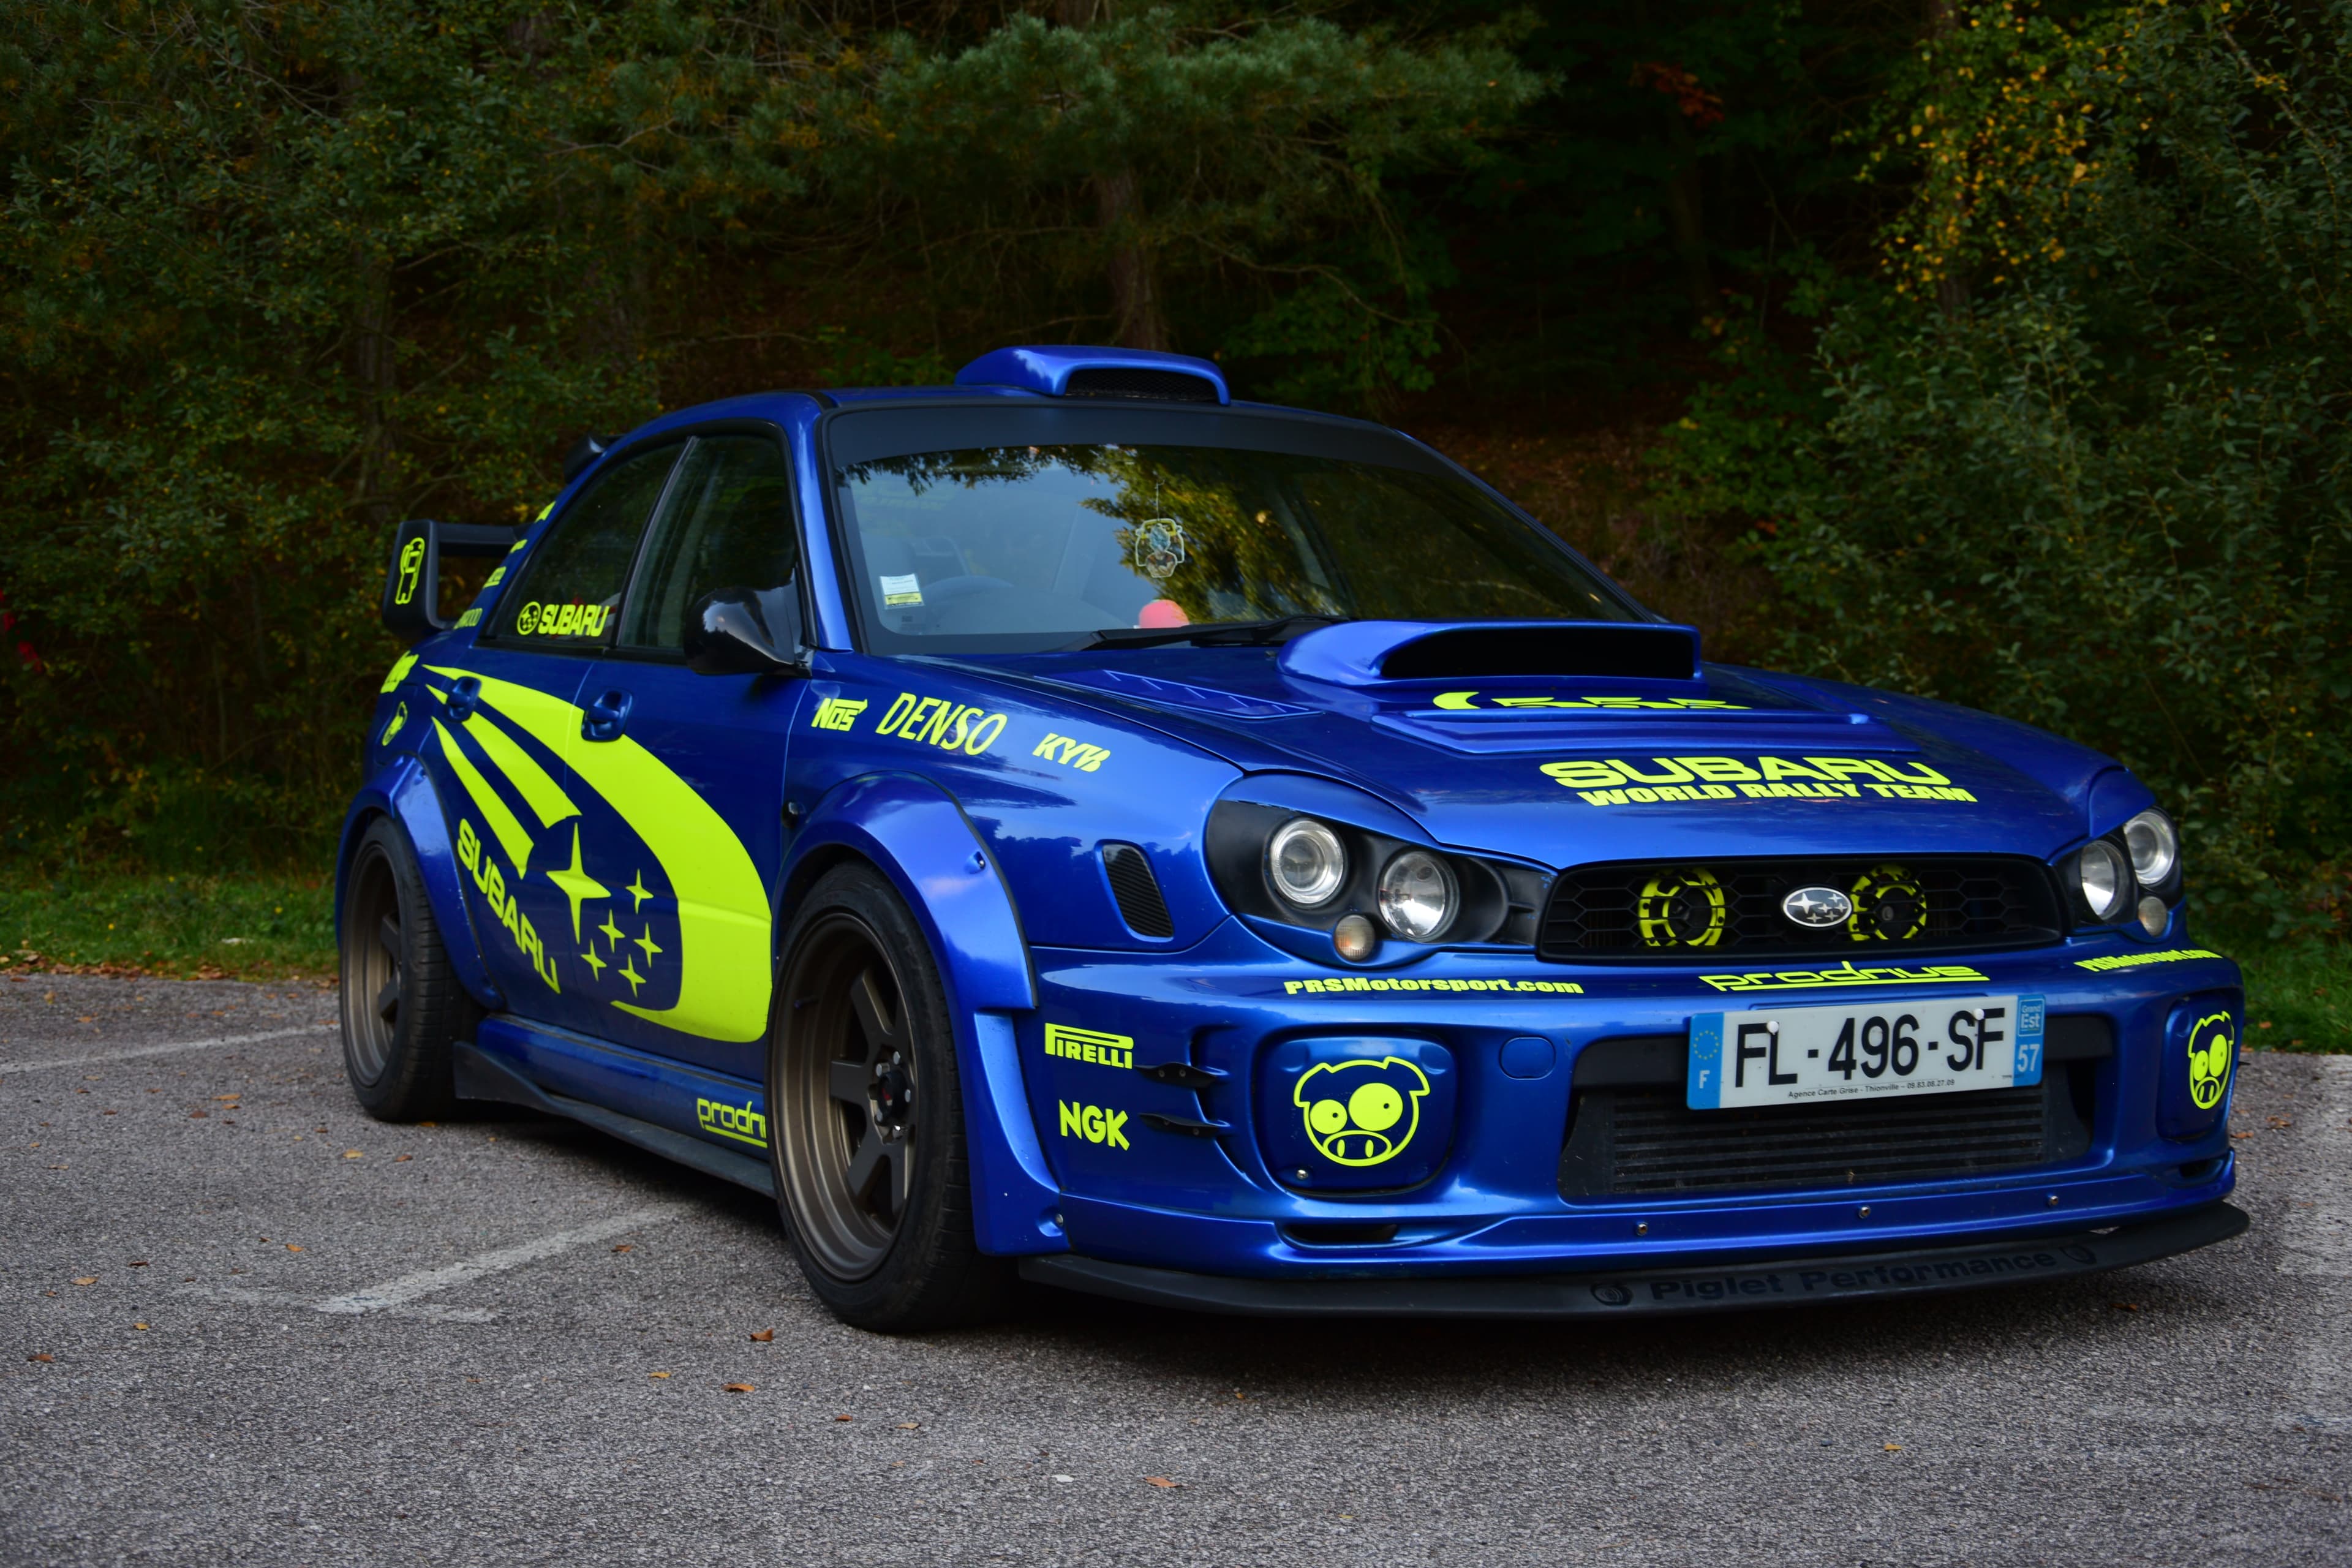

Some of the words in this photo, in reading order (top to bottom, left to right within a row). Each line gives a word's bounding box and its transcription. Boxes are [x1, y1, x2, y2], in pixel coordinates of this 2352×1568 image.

[538, 603, 610, 637] SUBARU
[812, 698, 868, 731] NOS
[875, 692, 1007, 755] DENSO
[1033, 733, 1110, 772] KYB
[1540, 756, 1951, 788] SUBARU
[1576, 784, 1736, 806] WORLD
[1736, 783, 1861, 798] RALLY
[1863, 783, 1978, 802] TEAM
[457, 818, 560, 994] SUBARU
[1284, 977, 1585, 995] PRSMotorsport.com
[1698, 960, 1990, 992] prodrive
[2021, 1012, 2041, 1028] Est
[2022, 1005, 2041, 1013] Grand
[1044, 1022, 1134, 1069] PIRELLI
[1735, 1008, 2005, 1087] FL-496-SF
[2018, 1043, 2040, 1072] 57
[1698, 1069, 1711, 1089] F
[1788, 1090, 1816, 1099] Agence
[1865, 1084, 1899, 1092] Thionville
[1059, 1099, 1130, 1151] NGK
[1650, 1275, 1784, 1300] Piglet
[1798, 1251, 2057, 1291] Performance
